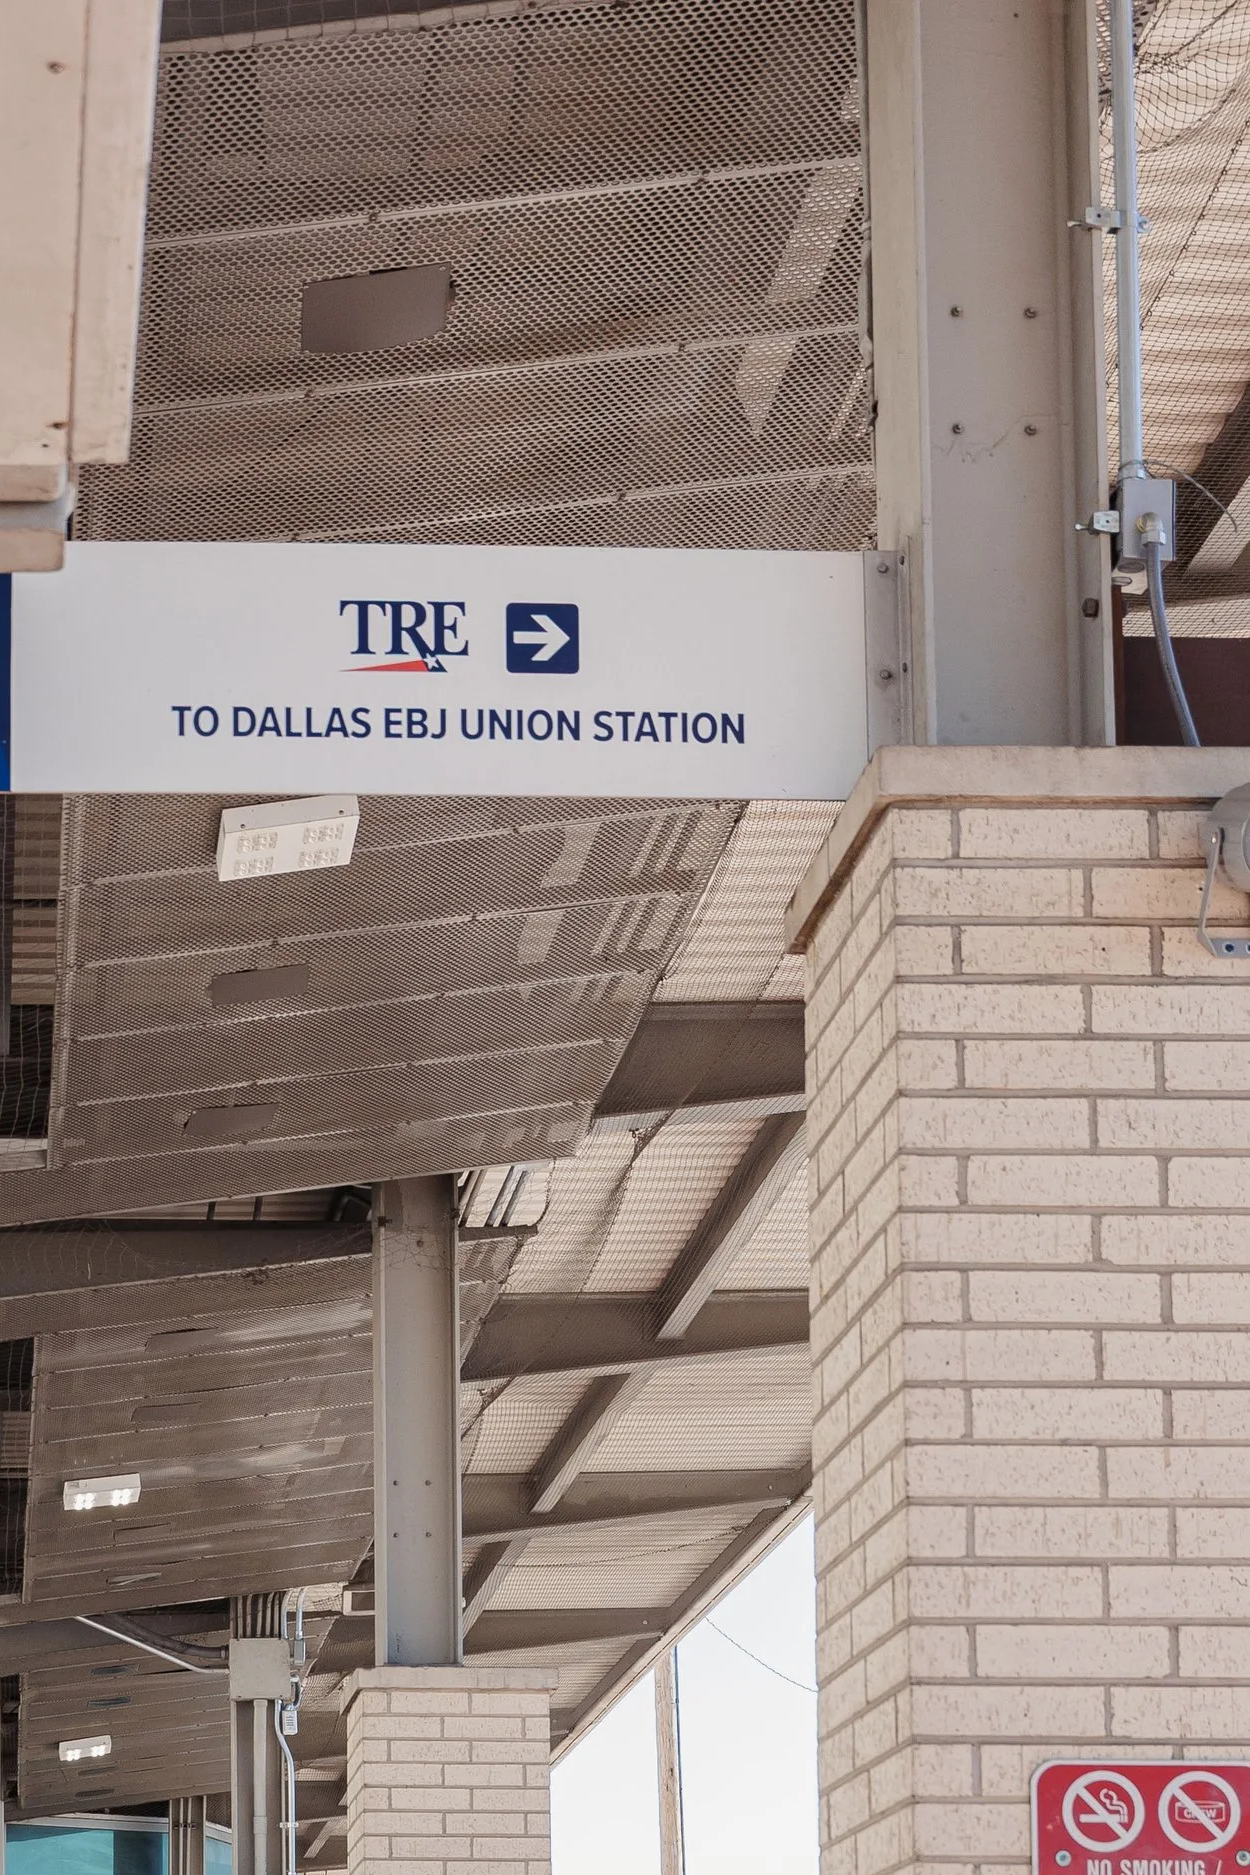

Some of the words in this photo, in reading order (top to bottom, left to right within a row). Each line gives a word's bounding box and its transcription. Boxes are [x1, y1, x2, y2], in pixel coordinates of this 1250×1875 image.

[339, 599, 470, 672] TRE
[171, 705, 219, 737] TO
[233, 705, 371, 739] DALLAS
[384, 707, 448, 740] EBJ
[461, 708, 581, 742] UNION
[593, 710, 746, 744] STATION
